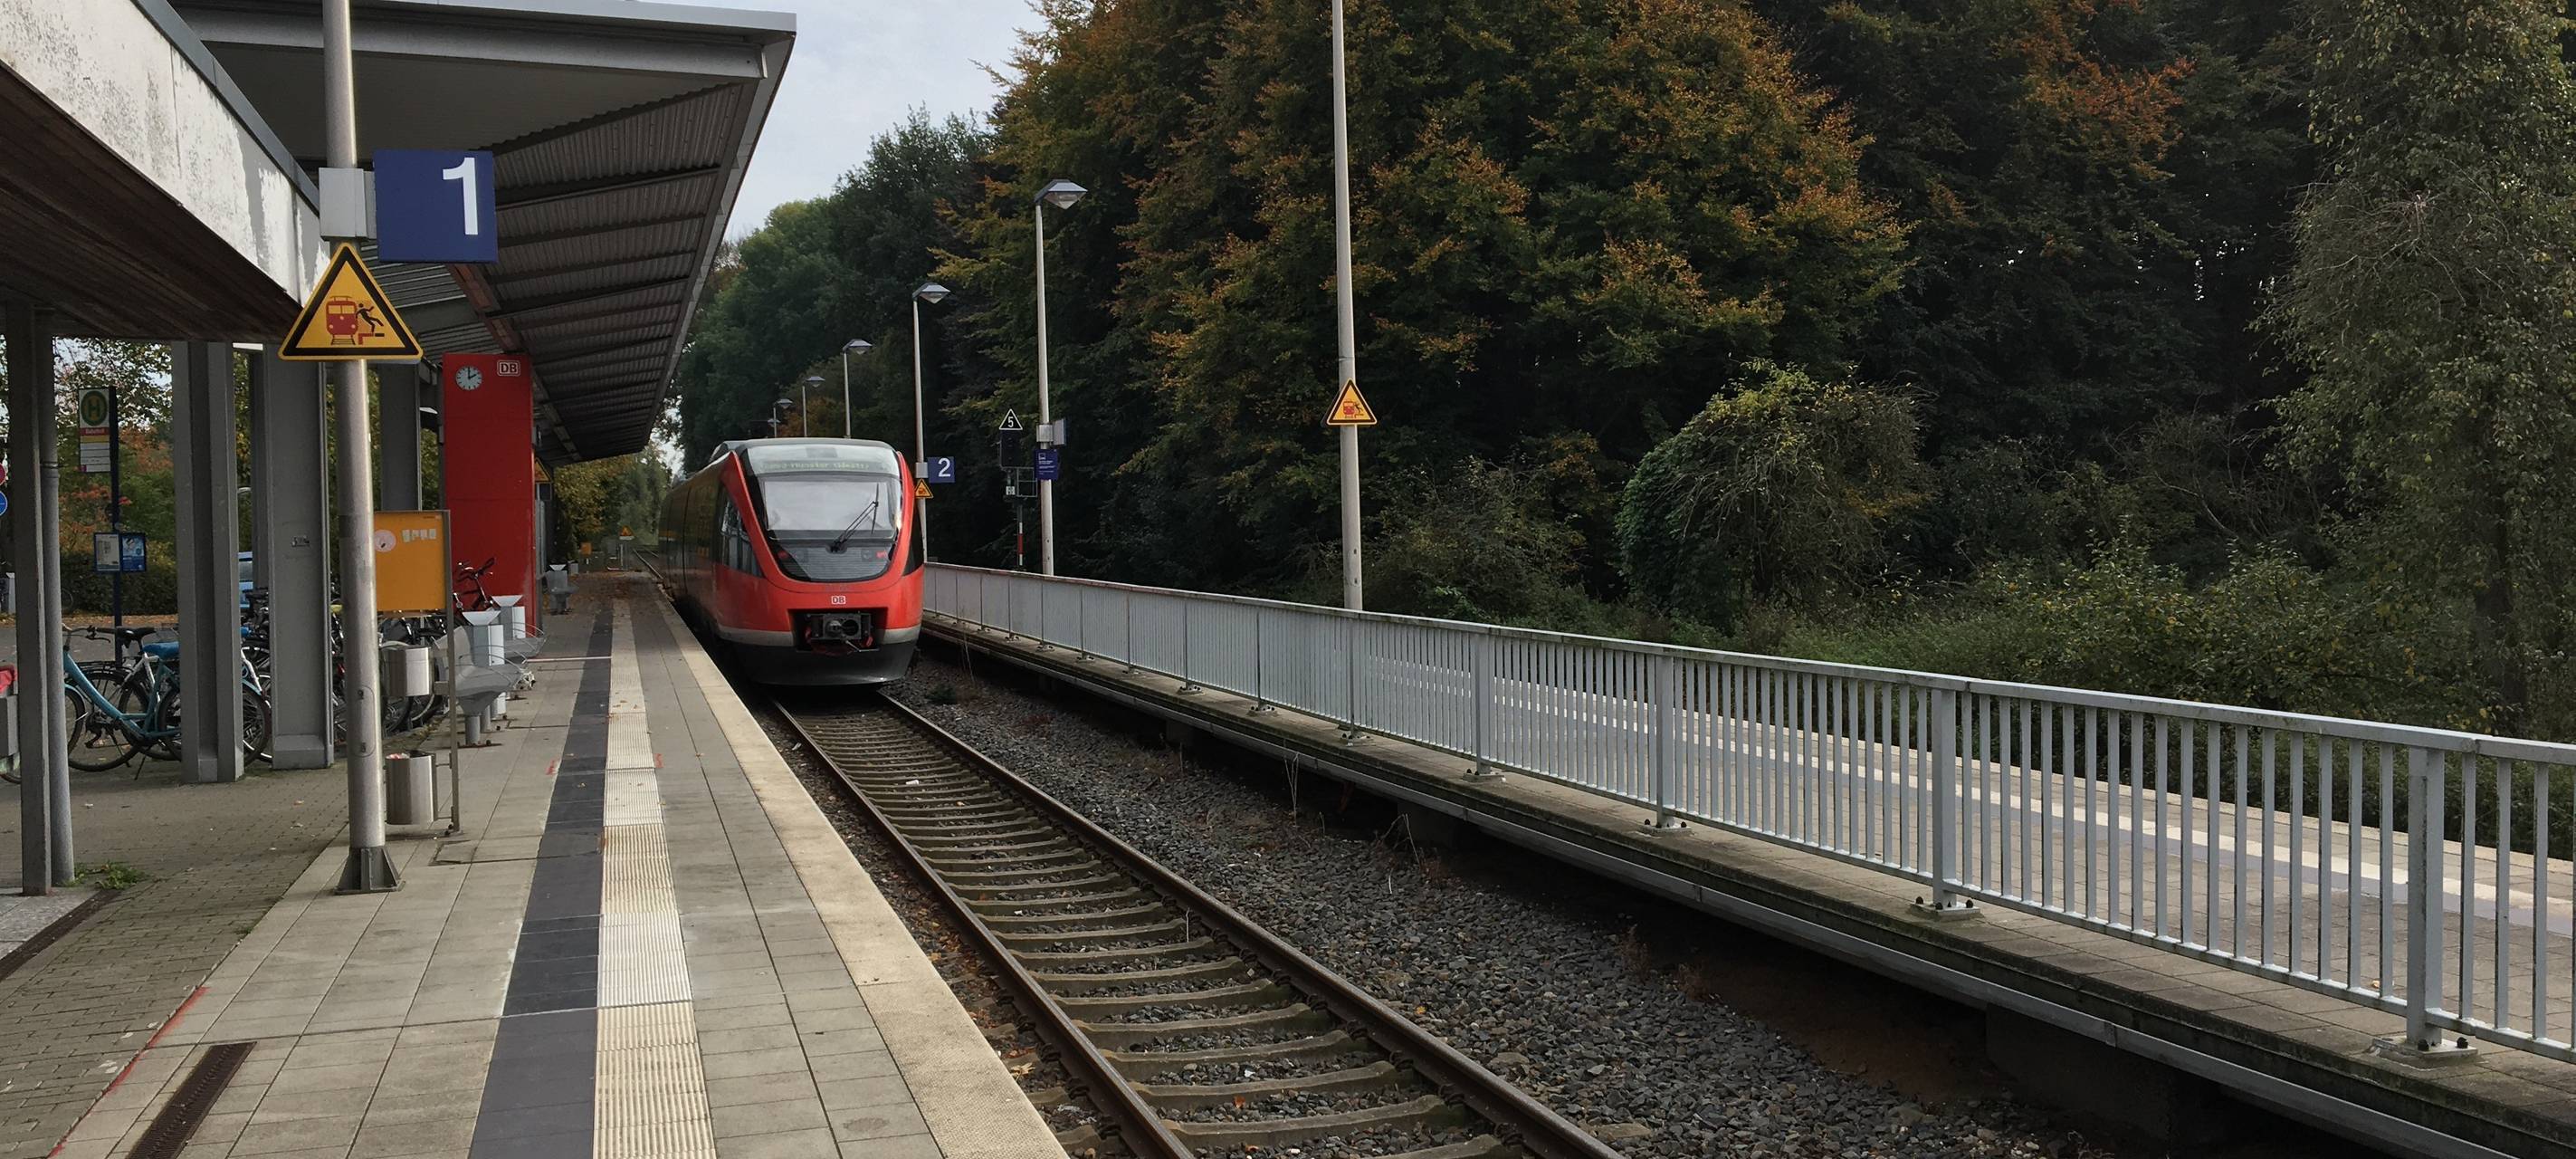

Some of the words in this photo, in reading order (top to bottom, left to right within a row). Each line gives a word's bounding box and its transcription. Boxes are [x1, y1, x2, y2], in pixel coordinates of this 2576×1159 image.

[443, 157, 479, 235] 1
[89, 398, 100, 419] H
[1007, 416, 1014, 427] 5
[938, 457, 951, 477] 2
